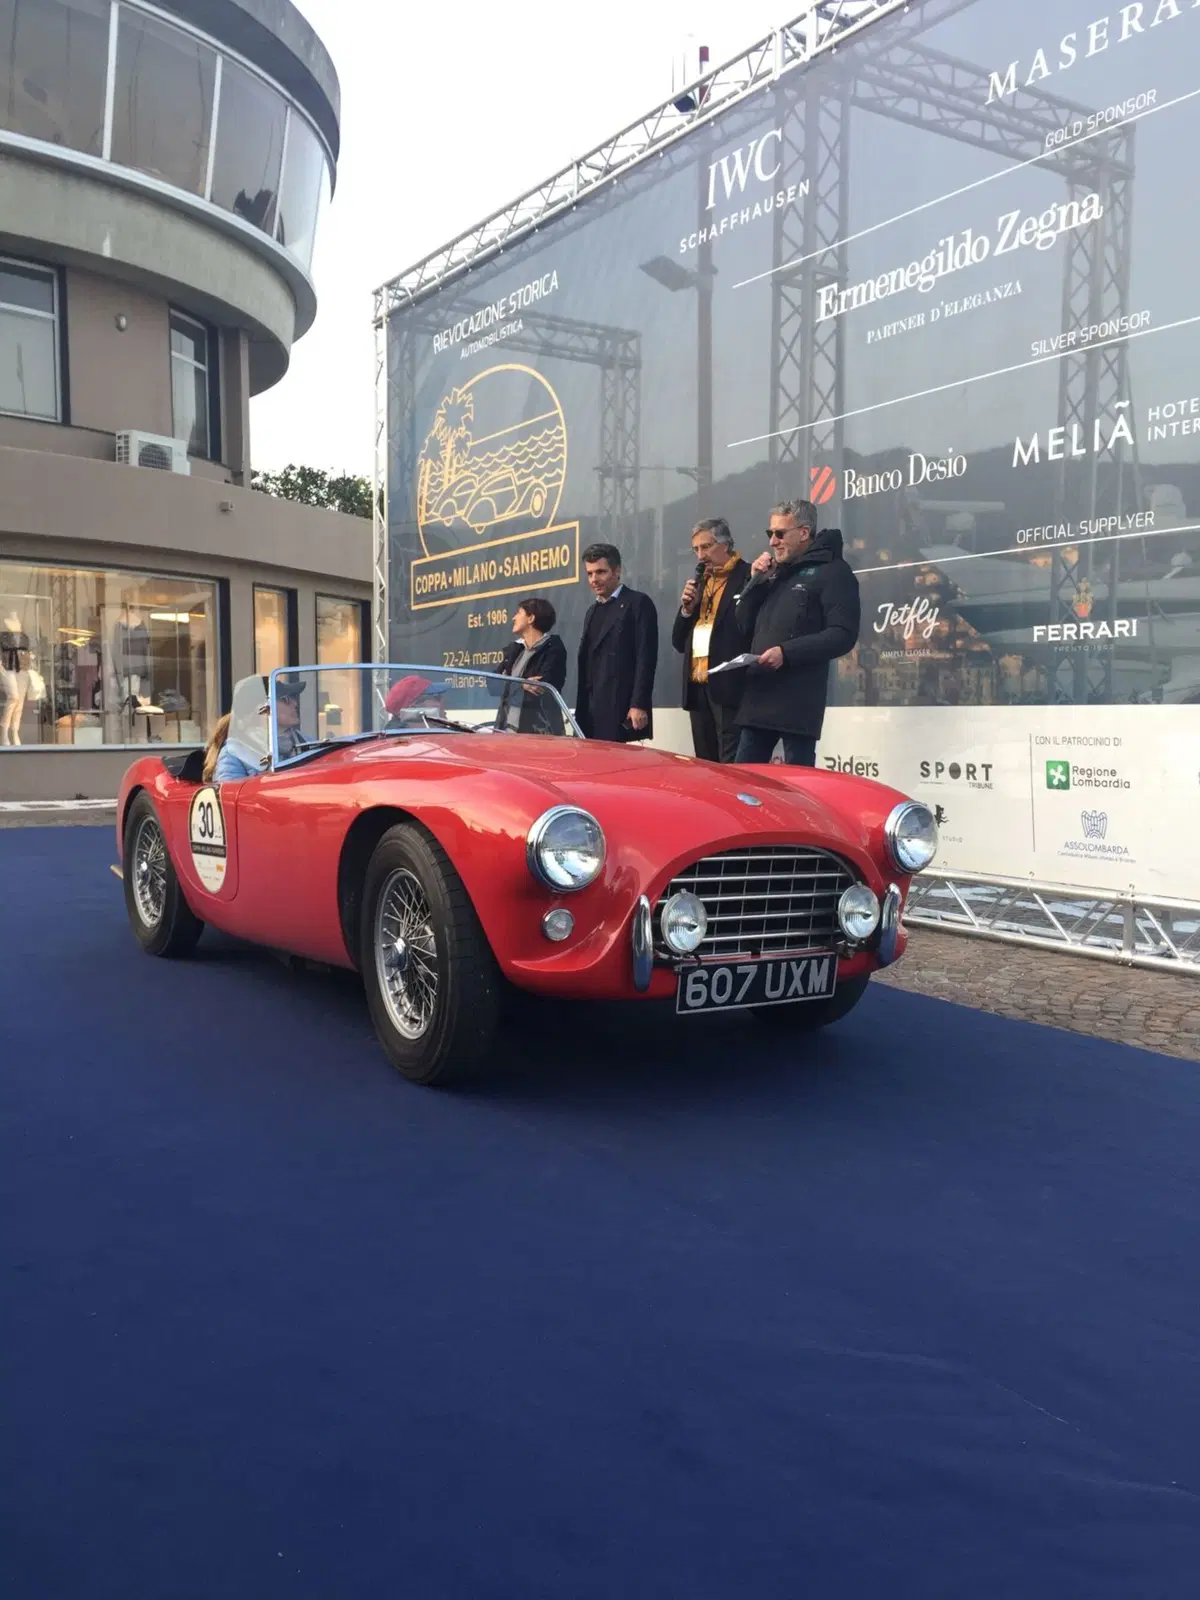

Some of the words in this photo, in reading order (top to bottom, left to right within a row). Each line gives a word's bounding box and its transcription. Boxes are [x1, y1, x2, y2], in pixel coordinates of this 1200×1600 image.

[985, 0, 1200, 105] MASERA
[1045, 121, 1082, 148] GOLD
[1086, 89, 1157, 131] SPONSOR
[705, 128, 782, 211] IWC
[680, 179, 810, 253] SCHAFFHAUSEN
[816, 228, 990, 322] Ermenegildo
[993, 193, 1103, 256] Zegna
[433, 297, 507, 355] RIEVOCAZIONE
[509, 269, 559, 314] STORICA
[867, 312, 925, 344] PARTNER
[930, 280, 1023, 322] D'ELEGANZA
[1031, 331, 1076, 356] SILVER
[1080, 310, 1150, 343] SPONSOR
[460, 318, 523, 360] AUTOMOBILISTICA
[1147, 417, 1200, 442] INTER
[1148, 397, 1200, 421] HOTE
[843, 466, 902, 500] Banco
[907, 447, 967, 487] Desio
[1016, 521, 1075, 544] OFFICIAL
[1079, 510, 1155, 536] SUPPLYER
[467, 613, 484, 628] Est.
[487, 609, 508, 625] 1906
[873, 596, 940, 640] Jetfly
[1032, 618, 1138, 643] FERRARI
[443, 650, 470, 668] 22-24
[472, 651, 504, 665] marzo
[1035, 735, 1051, 745] CON
[1053, 736, 1060, 745] IL
[1061, 736, 1111, 747] PATROCINIO
[1113, 737, 1122, 747] DI
[1072, 766, 1117, 778] Regione
[1072, 777, 1131, 789] Lombardia
[198, 801, 214, 838] 30
[1064, 841, 1129, 856] ASSOLOMBARDA
[685, 965, 758, 1008] 607
[764, 958, 830, 999] UXM
